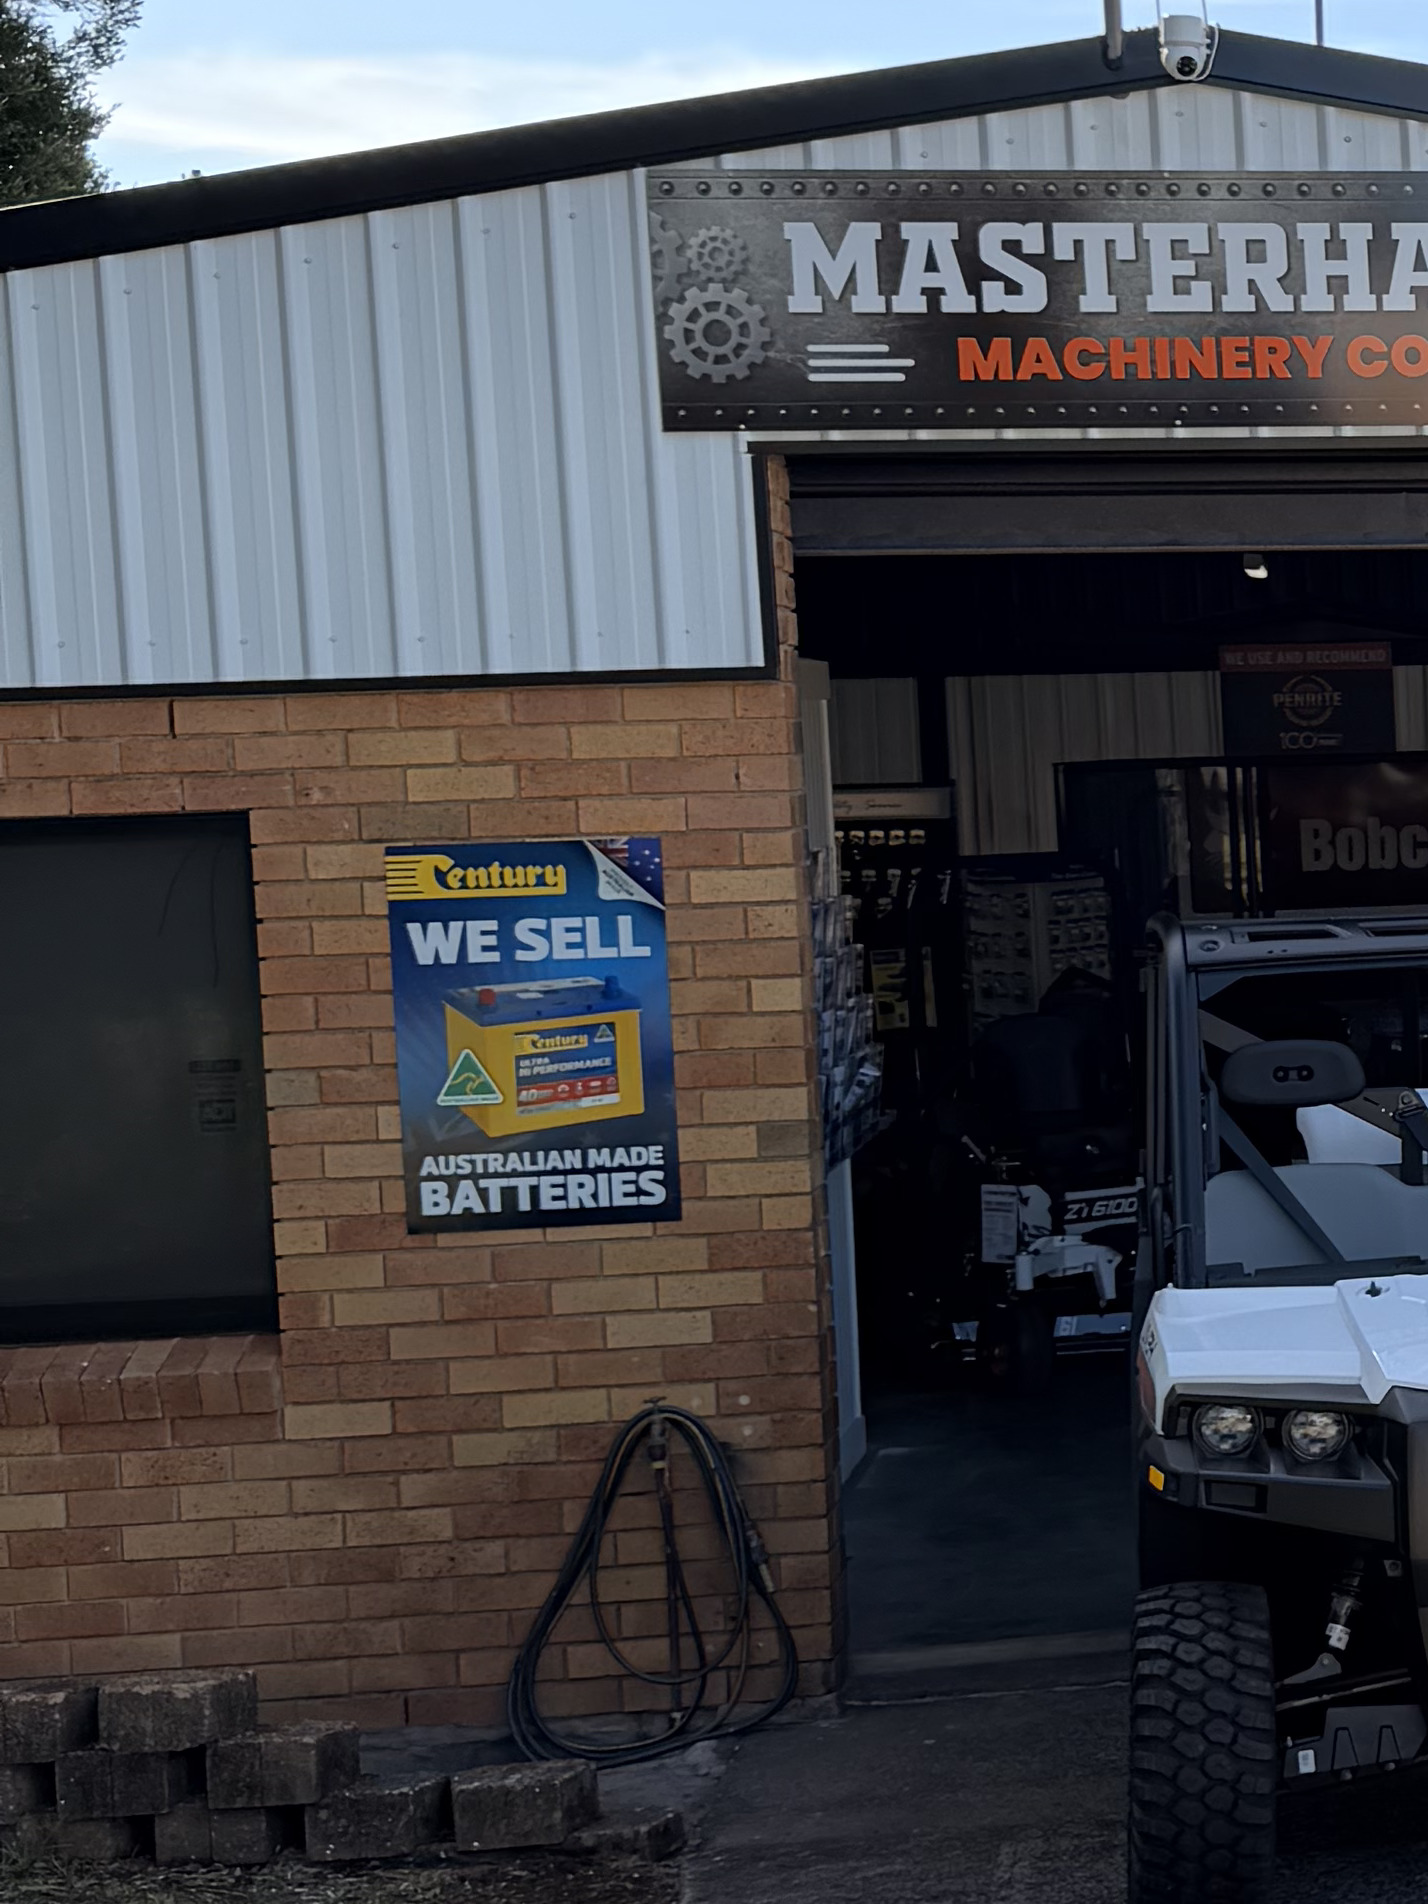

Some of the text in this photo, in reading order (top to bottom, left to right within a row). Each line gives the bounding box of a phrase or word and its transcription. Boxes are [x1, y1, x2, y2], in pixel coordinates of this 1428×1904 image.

[957, 333, 1334, 383] MACHINERY
[1248, 651, 1272, 665] USE
[1276, 650, 1304, 664] AND
[1307, 648, 1387, 663] RECOMMEND
[1272, 691, 1343, 707] PENRITE
[410, 854, 567, 899] Century
[406, 915, 651, 965] WE SELL
[419, 1145, 665, 1177] AUSTRALIAN MADE
[419, 1170, 667, 1217] BATTERIES
